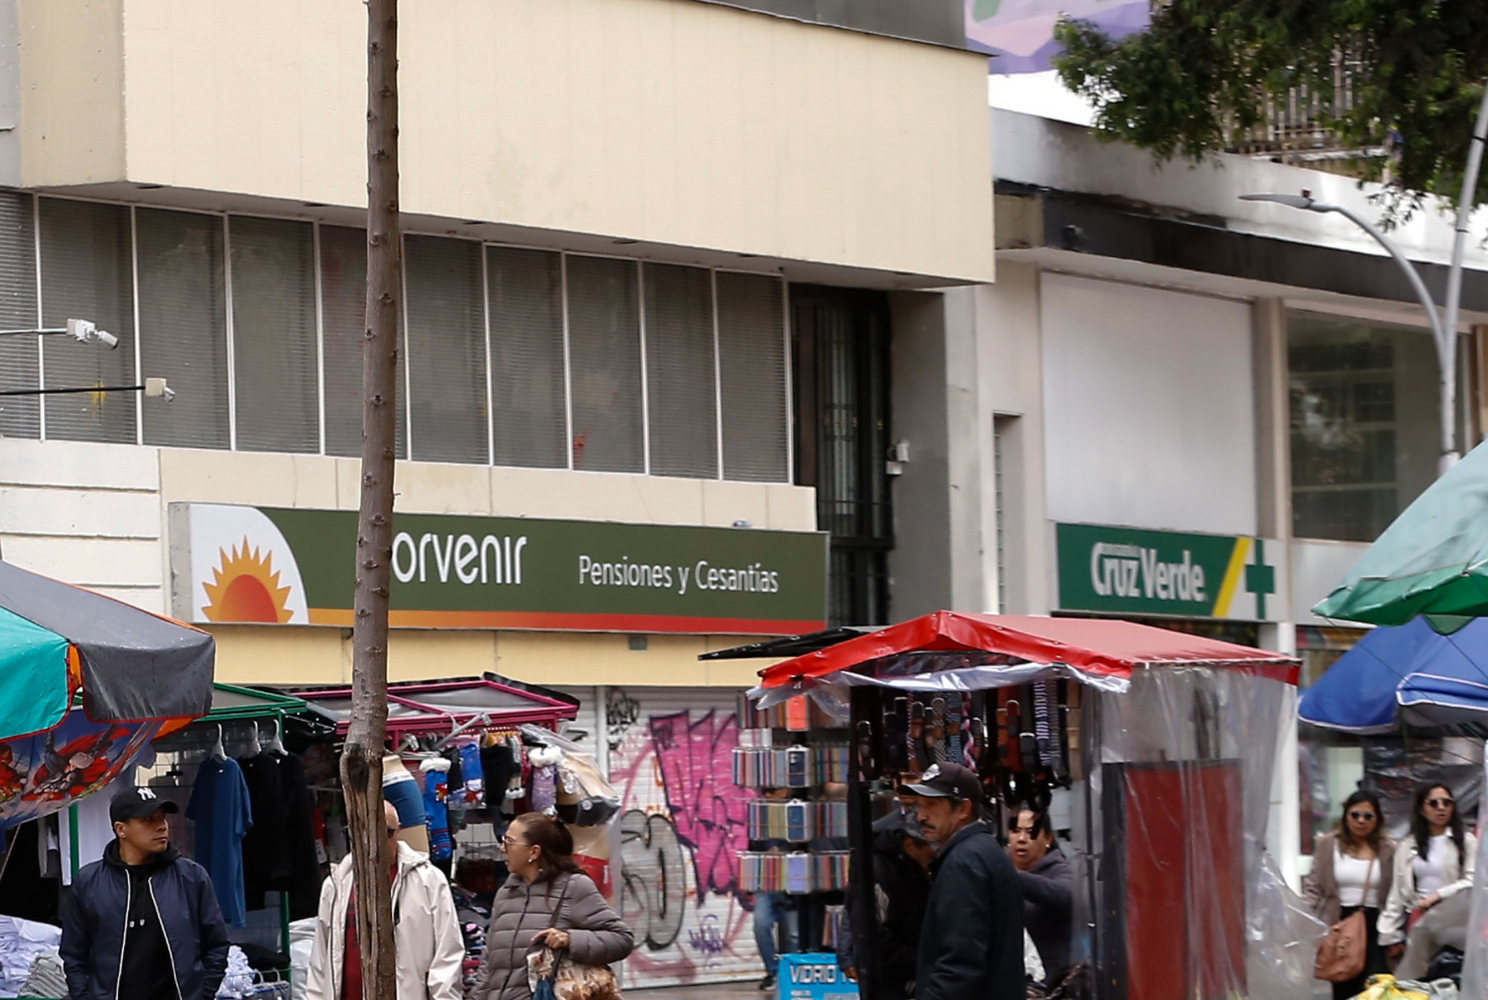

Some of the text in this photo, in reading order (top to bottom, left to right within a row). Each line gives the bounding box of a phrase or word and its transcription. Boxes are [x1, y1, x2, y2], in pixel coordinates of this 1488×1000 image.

[391, 531, 528, 585] orvenir
[578, 555, 780, 596] Pensiones y Cesantías
[1090, 541, 1206, 602] Cruz Verde
[789, 964, 837, 984] VIDRIO
